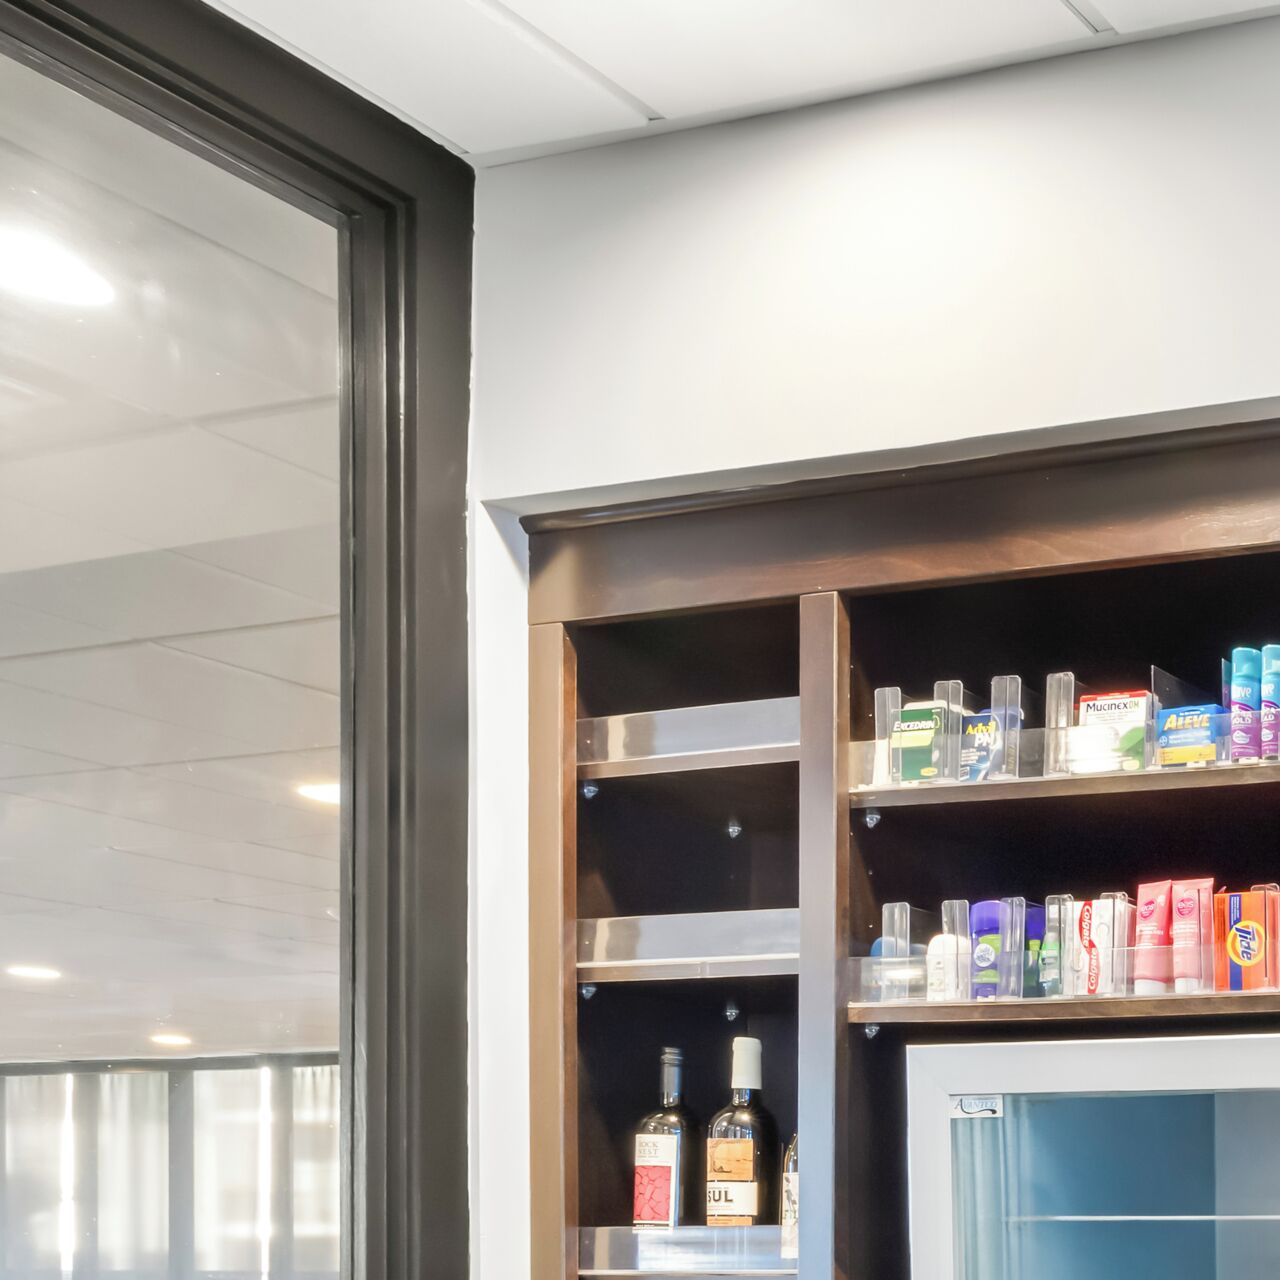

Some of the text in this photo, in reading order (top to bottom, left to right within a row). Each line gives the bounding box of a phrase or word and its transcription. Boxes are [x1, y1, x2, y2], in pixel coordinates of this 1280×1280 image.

[1163, 714, 1211, 731] ALEVE
[1081, 904, 1092, 948] Colgate
[1234, 925, 1257, 960] Tide
[1088, 948, 1098, 990] Colgate
